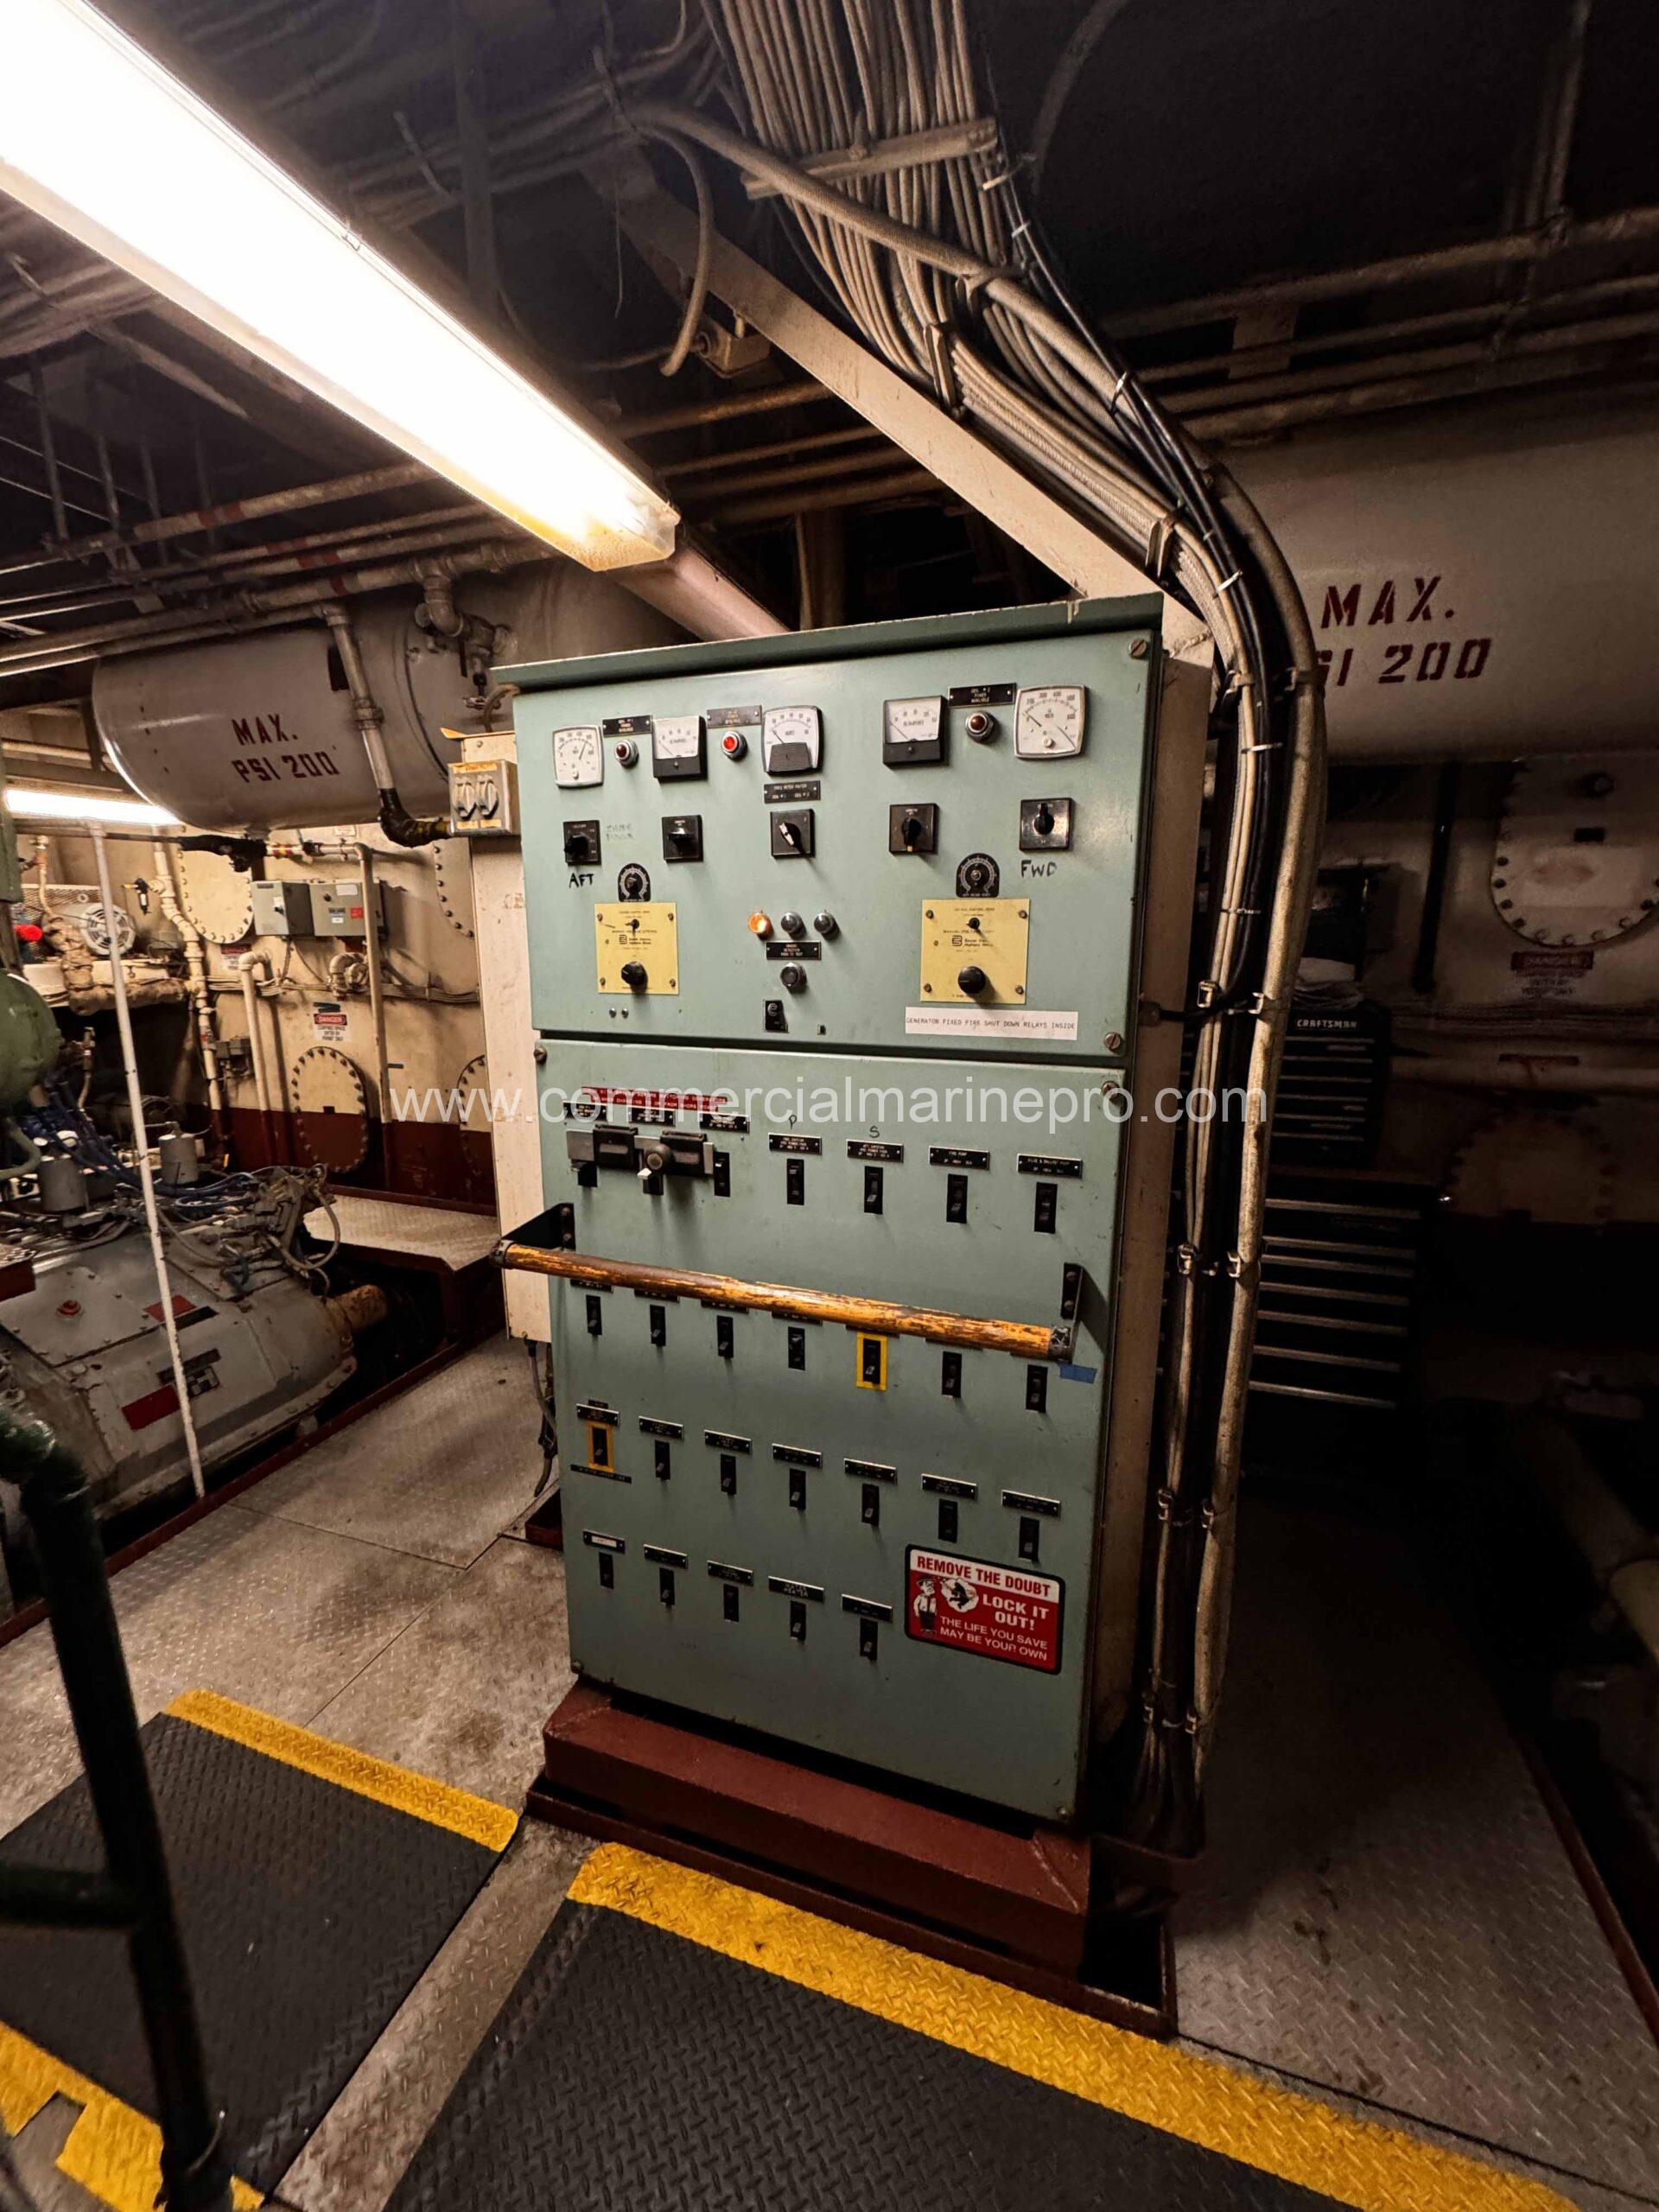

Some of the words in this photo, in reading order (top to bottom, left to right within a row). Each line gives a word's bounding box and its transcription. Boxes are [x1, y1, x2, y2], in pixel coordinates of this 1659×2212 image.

[1320, 576, 1455, 629] MAX.
[1377, 637, 1492, 684] 200
[231, 714, 298, 746] MAX.
[231, 757, 282, 783] PSI
[281, 751, 340, 779] 200
[569, 872, 594, 888] AFT
[1020, 860, 1058, 878] FWD
[906, 1016, 939, 1025] GENERATOR
[1296, 1020, 1357, 1028] CRAFTSMAN
[788, 1115, 798, 1129] P
[869, 1126, 880, 1138] S
[917, 1555, 972, 1579] REMOVE
[976, 1568, 1001, 1586] THE
[1005, 1575, 1051, 1597] DOUBT
[982, 1593, 1027, 1614] LOCK
[1033, 1605, 1049, 1619] IT
[940, 1615, 962, 1628] THE
[964, 1621, 988, 1634] LIFE
[990, 1628, 1014, 1641] YOU
[1016, 1634, 1048, 1649] SAVE
[995, 1611, 1035, 1630] OUT!
[940, 1626, 964, 1639] MAY
[967, 1633, 982, 1643] BE
[984, 1638, 1016, 1652] YOUR
[1019, 1646, 1047, 1661] OWN
